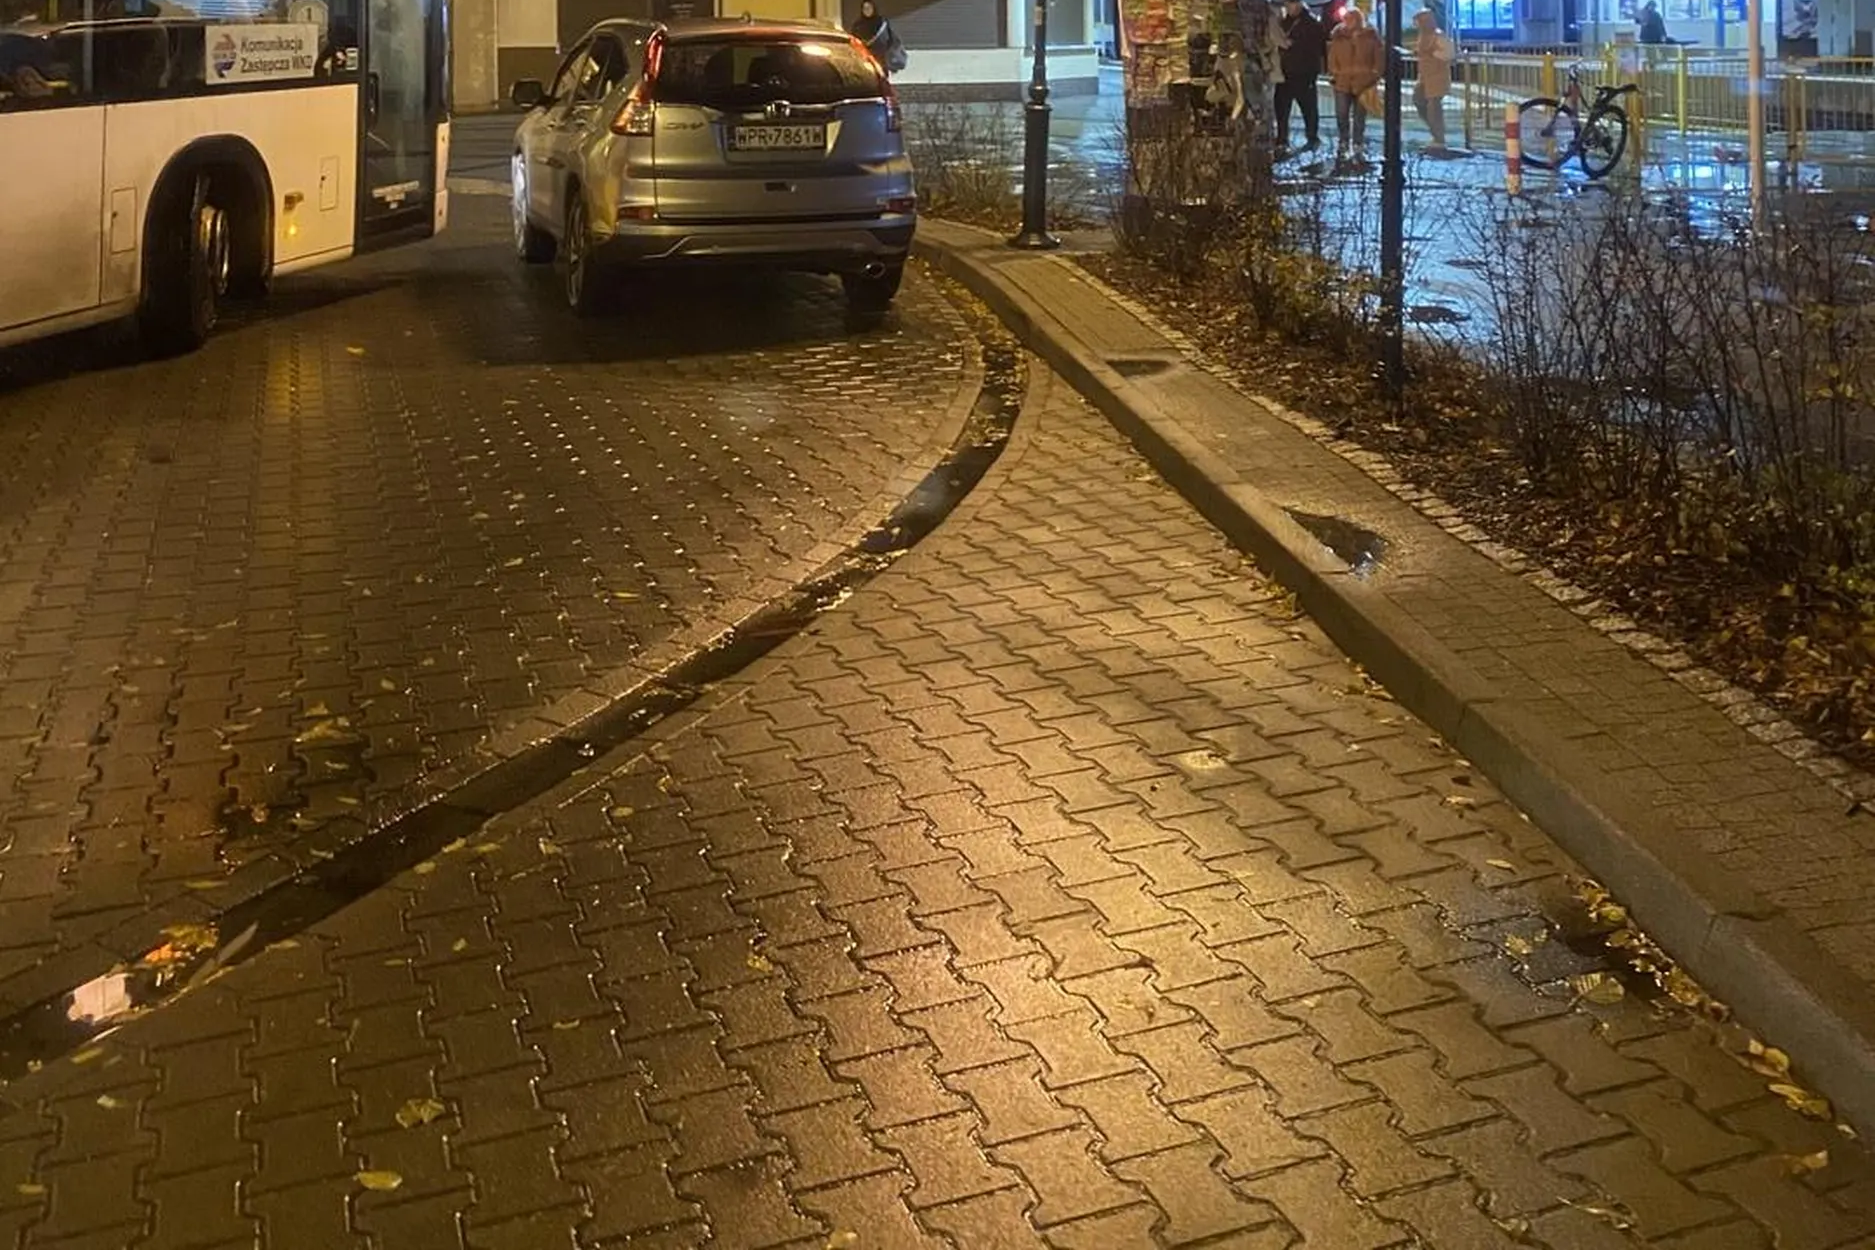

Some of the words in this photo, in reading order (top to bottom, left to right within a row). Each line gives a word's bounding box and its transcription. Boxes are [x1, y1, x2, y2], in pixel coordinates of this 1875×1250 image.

[241, 35, 303, 54] Komunikacja
[241, 56, 290, 74] Zastępcza
[736, 127, 769, 145] WPR
[773, 127, 822, 145] 7861W
